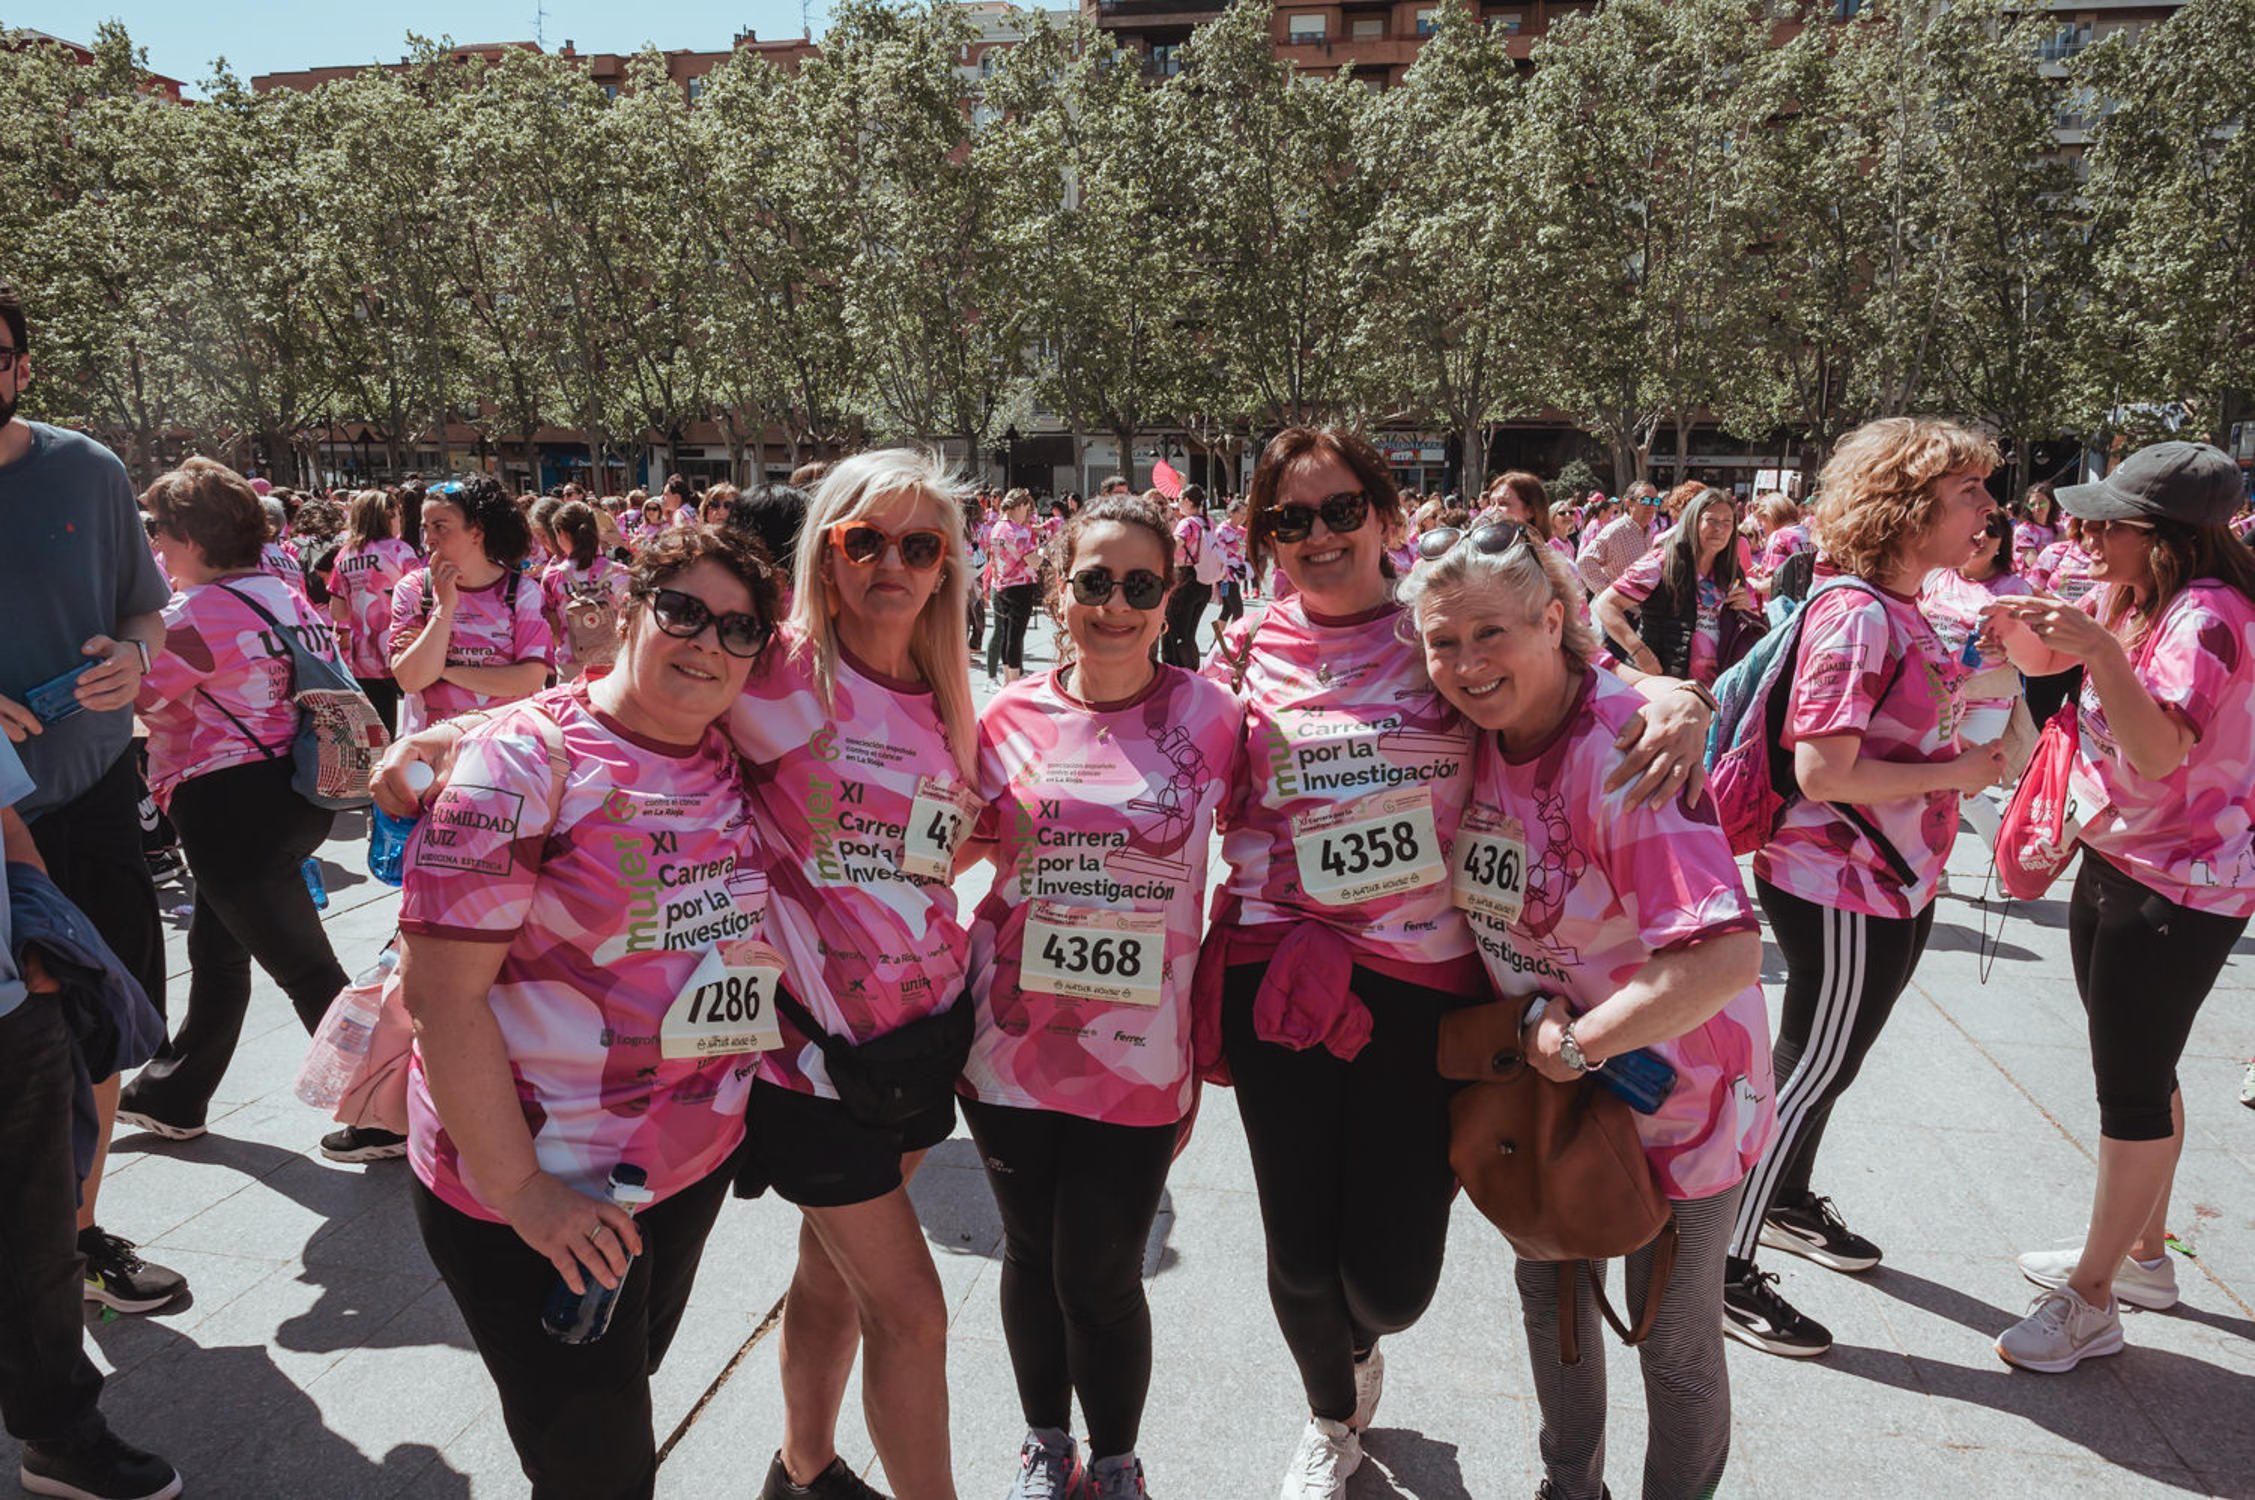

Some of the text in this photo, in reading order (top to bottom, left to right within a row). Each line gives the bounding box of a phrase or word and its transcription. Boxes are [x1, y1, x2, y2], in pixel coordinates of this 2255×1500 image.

[450, 645, 493, 656] arrera
[1301, 705, 1325, 717] XI
[1297, 716, 1399, 738] Carrera
[1299, 739, 1373, 770] por la
[1302, 757, 1459, 791] Investigación
[839, 780, 864, 804] XI
[1038, 800, 1060, 819] XI
[424, 829, 458, 848] RUIZ
[807, 773, 841, 880] mujer
[1037, 827, 1125, 847] Carrera
[649, 831, 678, 856] XI
[1012, 799, 1039, 896] mujer
[1321, 821, 1419, 877] 4358
[658, 856, 736, 888] Carrera
[1038, 854, 1100, 875] por la
[612, 833, 663, 953] mujer
[1037, 878, 1174, 903] Investigación
[666, 889, 731, 929] por la
[1042, 933, 1141, 977] 4368
